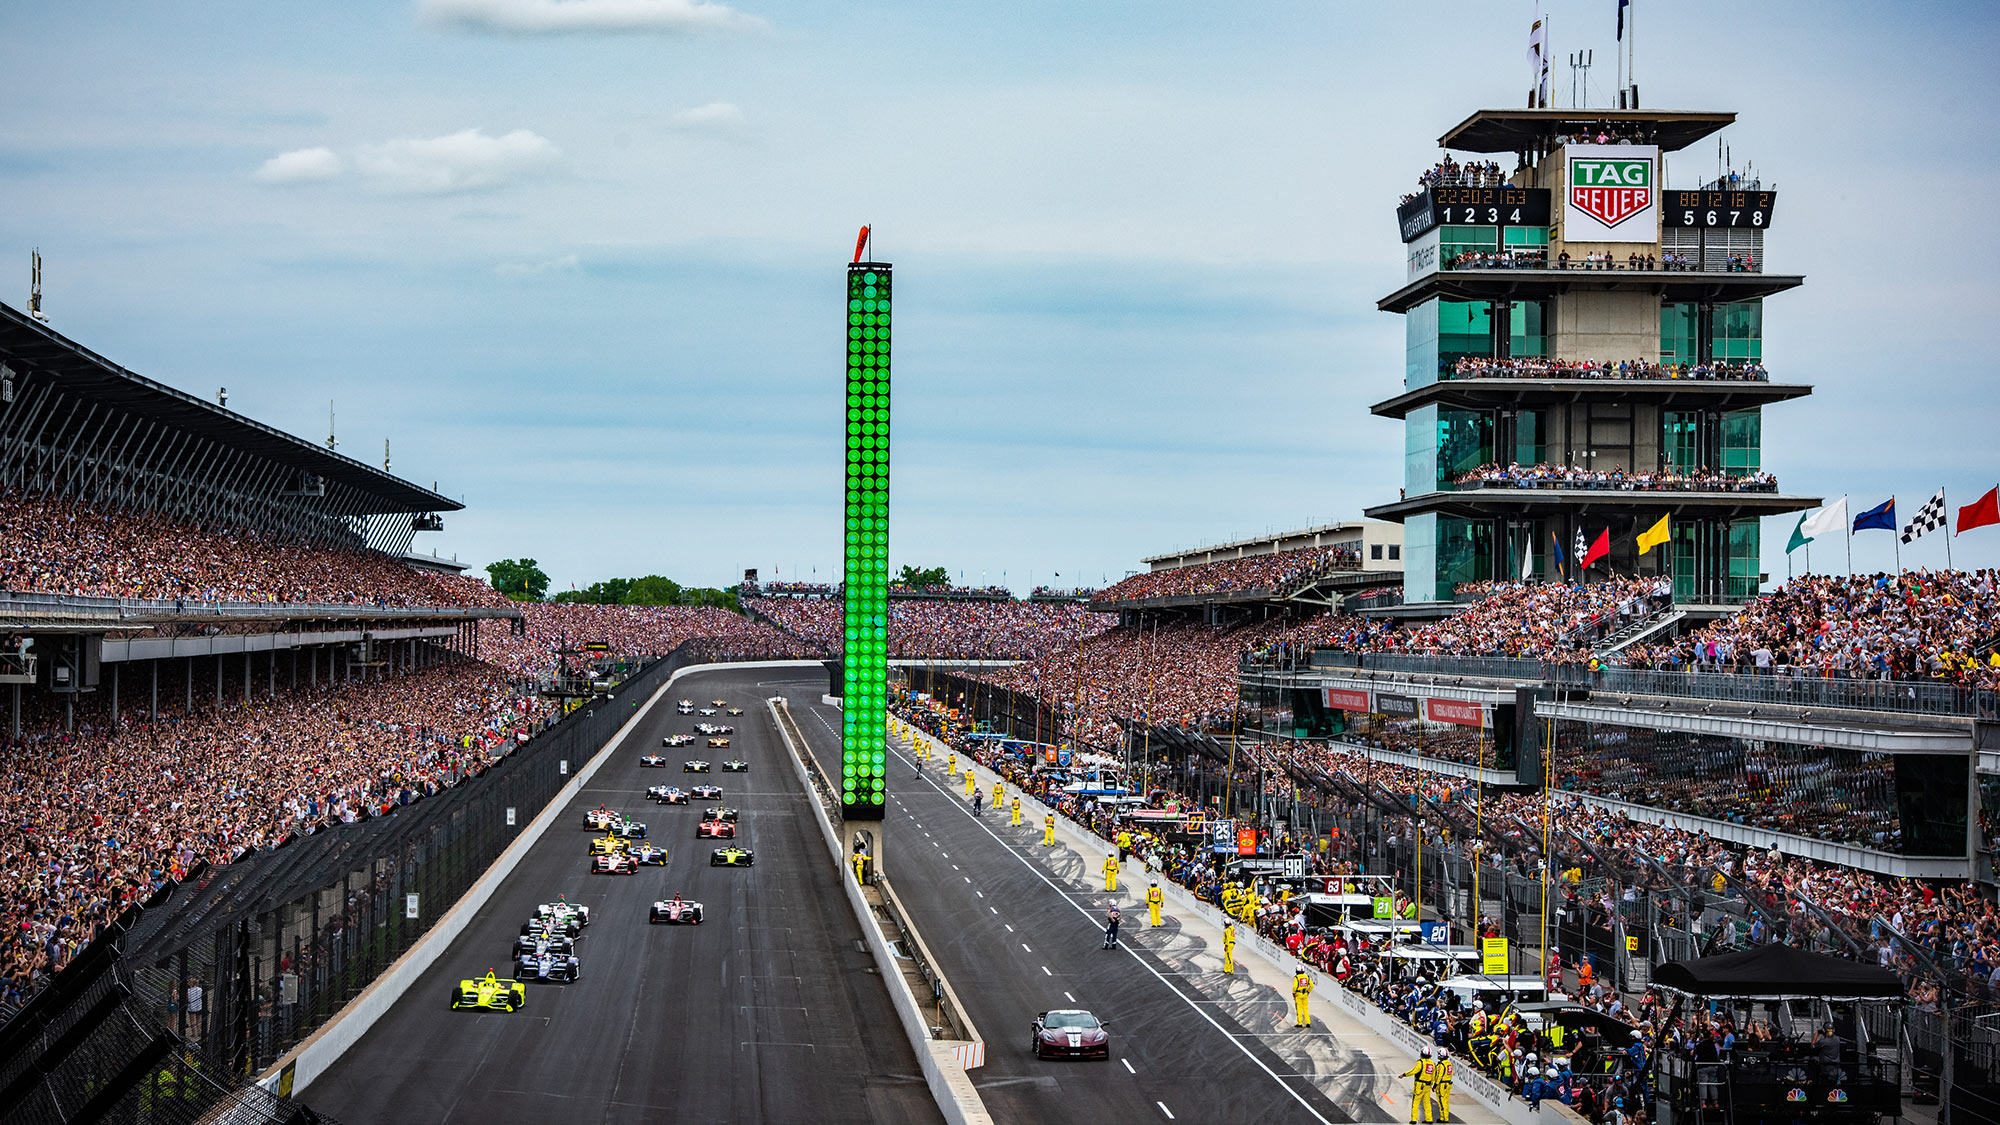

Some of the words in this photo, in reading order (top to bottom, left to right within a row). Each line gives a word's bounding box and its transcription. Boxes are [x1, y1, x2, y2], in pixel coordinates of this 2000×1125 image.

[1578, 163, 1643, 185] TAG
[1438, 189, 1457, 204] 22
[1461, 189, 1480, 205] 20
[1483, 189, 1503, 205] 21
[1506, 190, 1526, 205] 63
[1576, 189, 1646, 221] HEUER
[1679, 192, 1699, 207] 88
[1708, 192, 1722, 207] 12
[1731, 192, 1745, 207] 18
[1759, 193, 1769, 208] 2
[1443, 207, 1452, 223] 1
[1464, 207, 1475, 223] 2
[1487, 207, 1498, 223] 3
[1509, 208, 1521, 223] 4
[1683, 210, 1695, 225] 5
[1706, 210, 1717, 225] 6
[1729, 211, 1741, 226] 7
[1752, 211, 1763, 226] 8
[1215, 824, 1231, 840] 25
[1285, 858, 1302, 876] 98
[1327, 880, 1340, 893] 63
[1376, 901, 1390, 914] 21
[1668, 917, 1674, 926] 2
[1431, 926, 1447, 942] 20
[1629, 937, 1638, 949] 22
